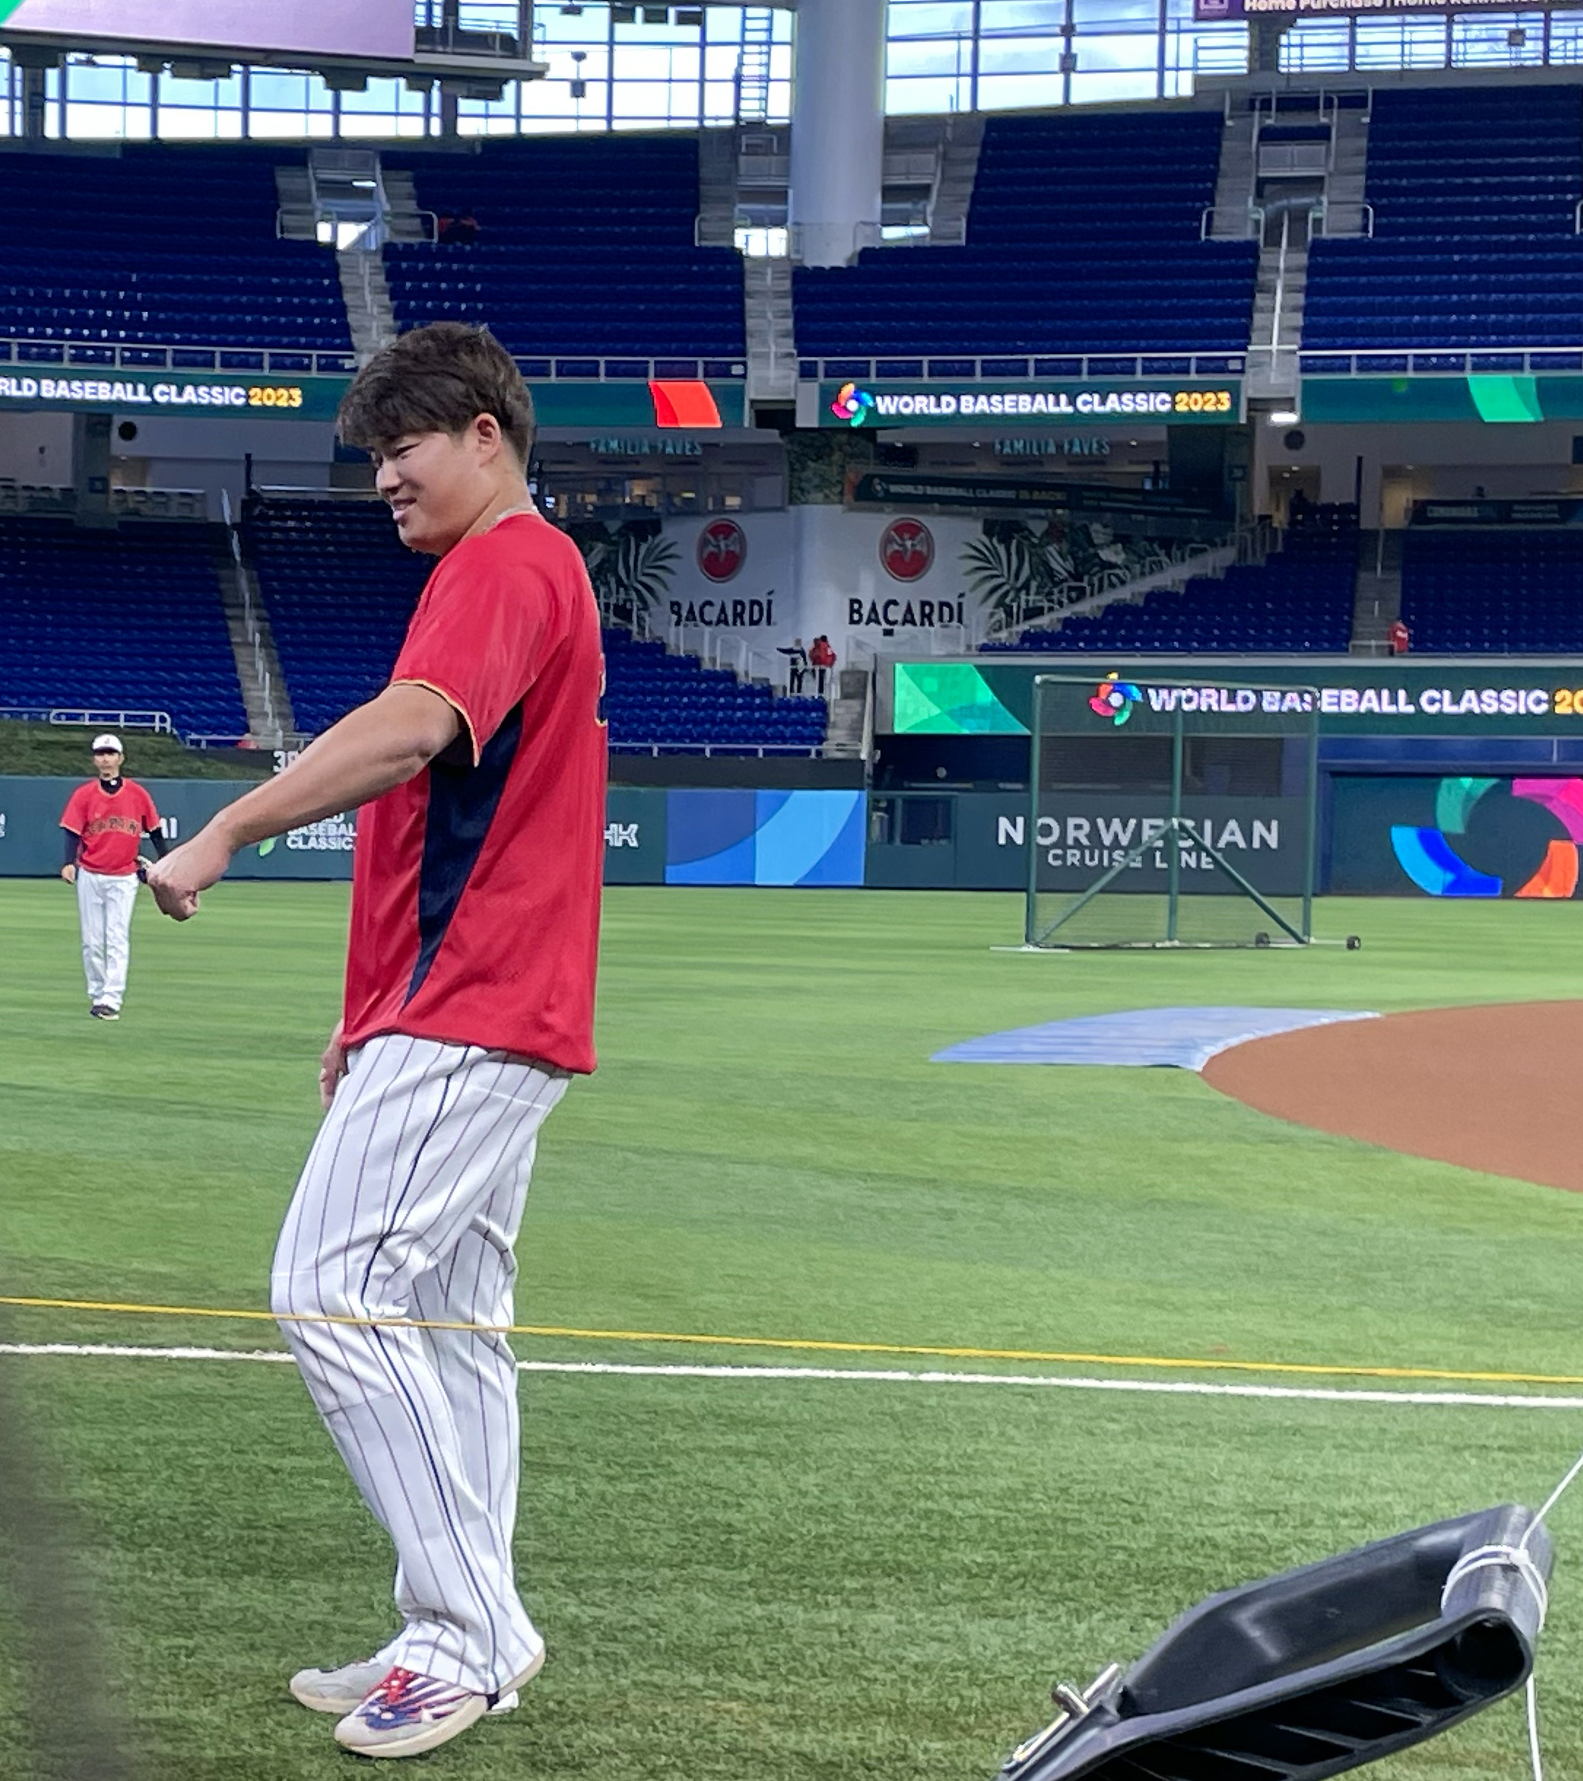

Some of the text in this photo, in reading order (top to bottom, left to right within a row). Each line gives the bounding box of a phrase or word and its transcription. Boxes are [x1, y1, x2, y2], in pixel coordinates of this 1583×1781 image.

[40, 379, 152, 403] BASEBALL
[153, 383, 246, 405] CLASSIC
[248, 386, 303, 408] 2023
[876, 391, 1231, 415] WORLD BASEBALL CLASSIC 2023
[994, 436, 1111, 455] FAMILIA FAVES
[669, 589, 775, 627] BACARDÍ
[848, 592, 965, 627] BACARDÍ
[1147, 687, 1256, 712] WORLD
[1419, 688, 1549, 715] CLASSIC
[1155, 850, 1223, 869] LNE
